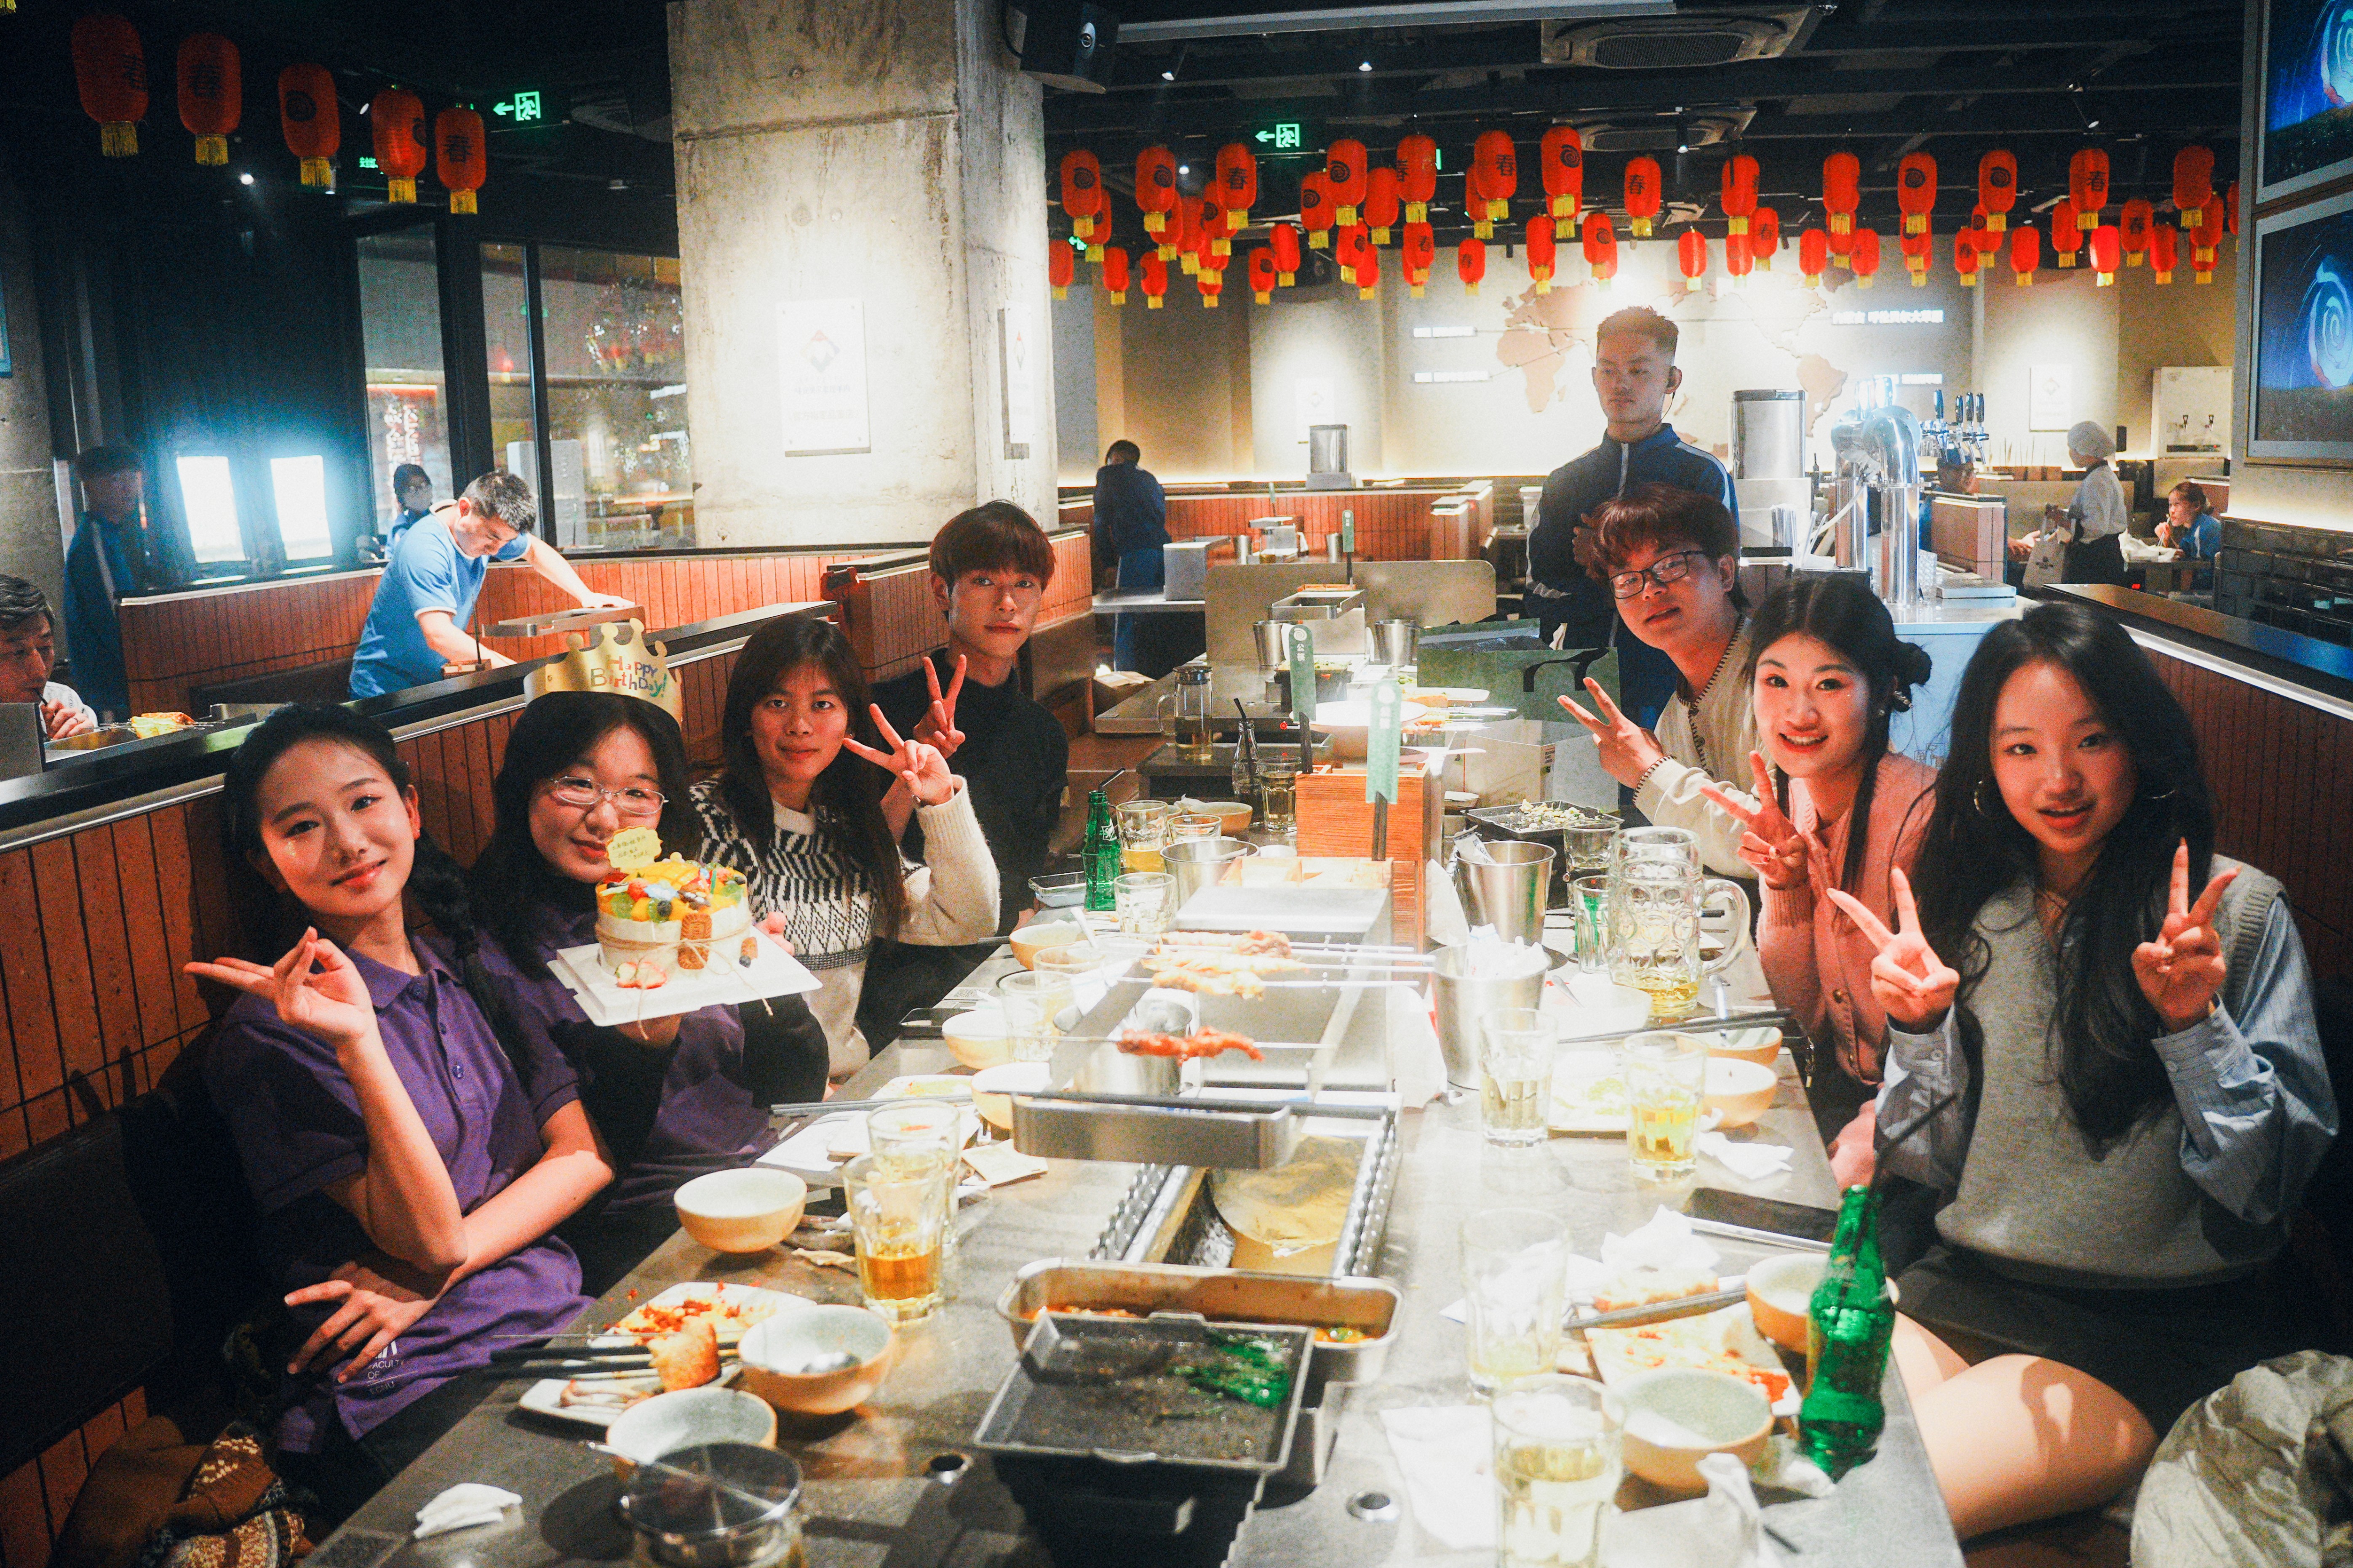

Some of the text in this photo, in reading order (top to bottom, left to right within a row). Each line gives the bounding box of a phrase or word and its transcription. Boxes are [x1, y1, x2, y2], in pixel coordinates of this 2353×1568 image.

[189, 63, 225, 98] 春
[444, 135, 473, 163] 春
[359, 156, 379, 168] 安全出
[1496, 154, 1516, 176] 春
[1226, 167, 1248, 189] 春
[1629, 174, 1645, 195] 春
[2086, 171, 2106, 192] 春
[1296, 643, 1306, 662] 公筷
[606, 654, 658, 677] Happy
